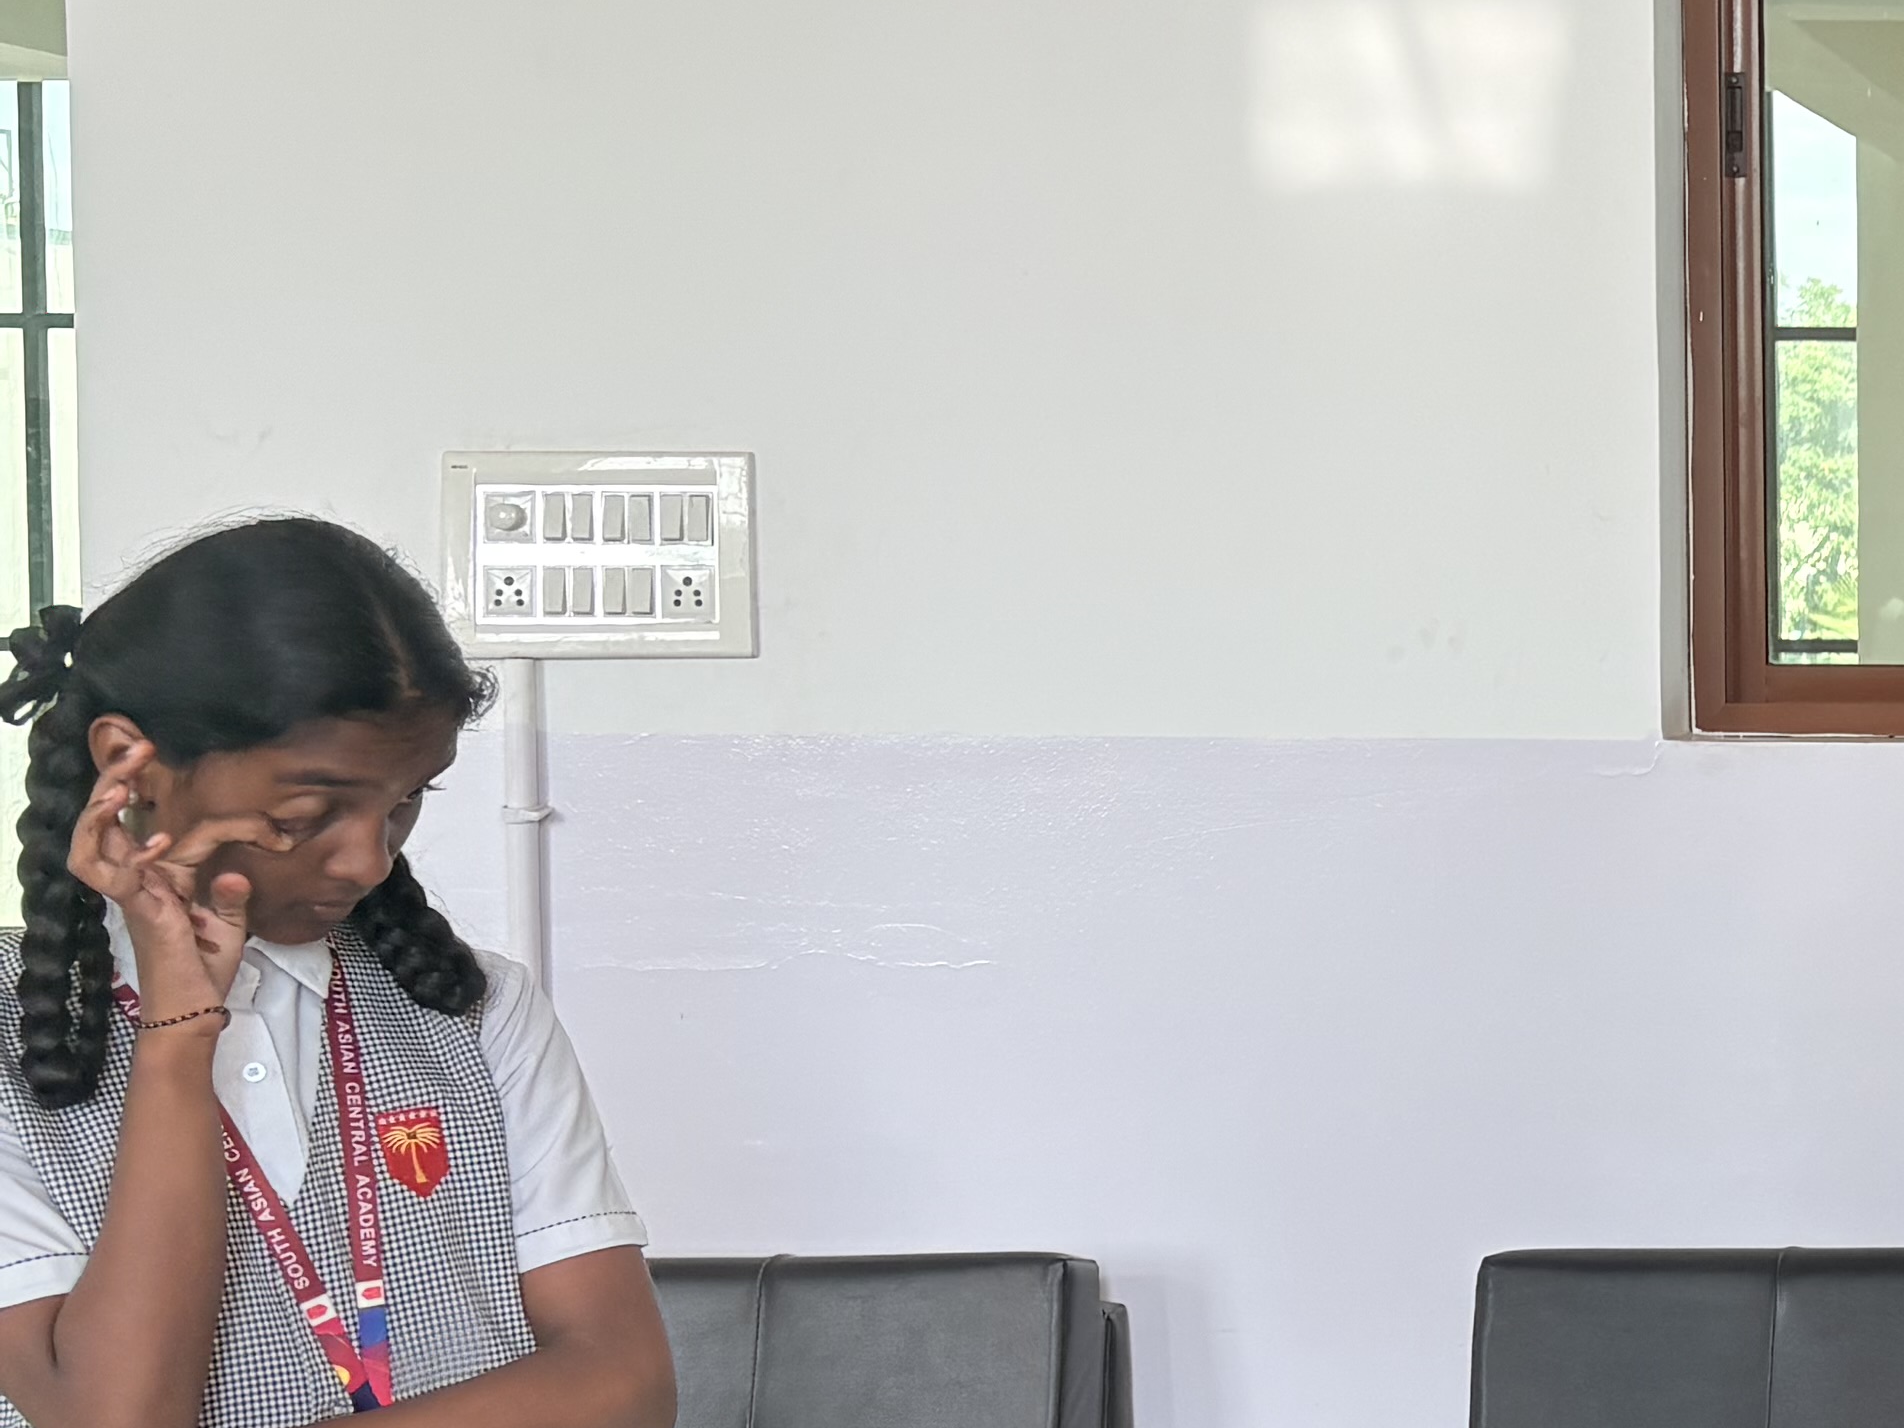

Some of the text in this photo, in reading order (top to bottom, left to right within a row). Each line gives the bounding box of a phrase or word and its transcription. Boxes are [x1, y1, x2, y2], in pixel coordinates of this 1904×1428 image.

[336, 1020, 355, 1074] ASIAN
[344, 1082, 368, 1167] CENTRAL
[236, 1168, 310, 1291] SOUTH ASIAN
[356, 1174, 379, 1268] ACADEMY
